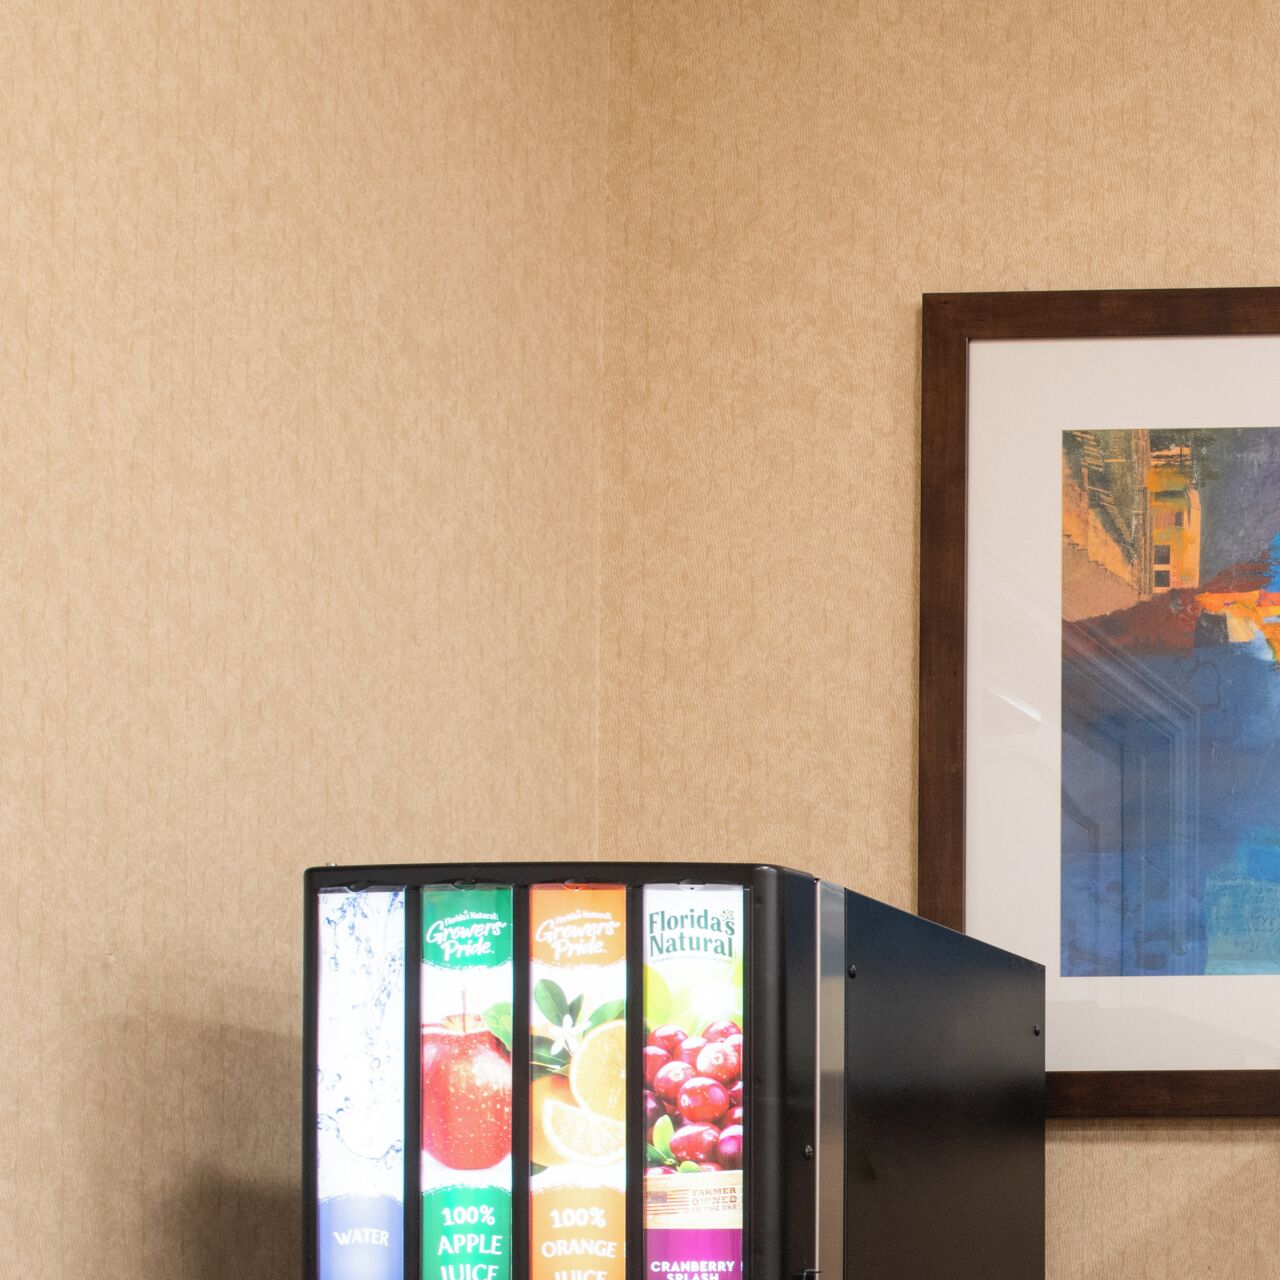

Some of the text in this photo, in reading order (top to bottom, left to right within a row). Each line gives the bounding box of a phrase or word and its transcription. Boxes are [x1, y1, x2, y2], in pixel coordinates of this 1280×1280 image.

[426, 920, 507, 944] Growers
[650, 932, 733, 958] Natural
[441, 1204, 496, 1226] 100%
[550, 1206, 607, 1229] 100%
[332, 1228, 390, 1247] WATER
[437, 1233, 503, 1256] APPLE
[541, 1238, 618, 1259] ORANGE
[650, 1261, 735, 1272] CRANBERRY
